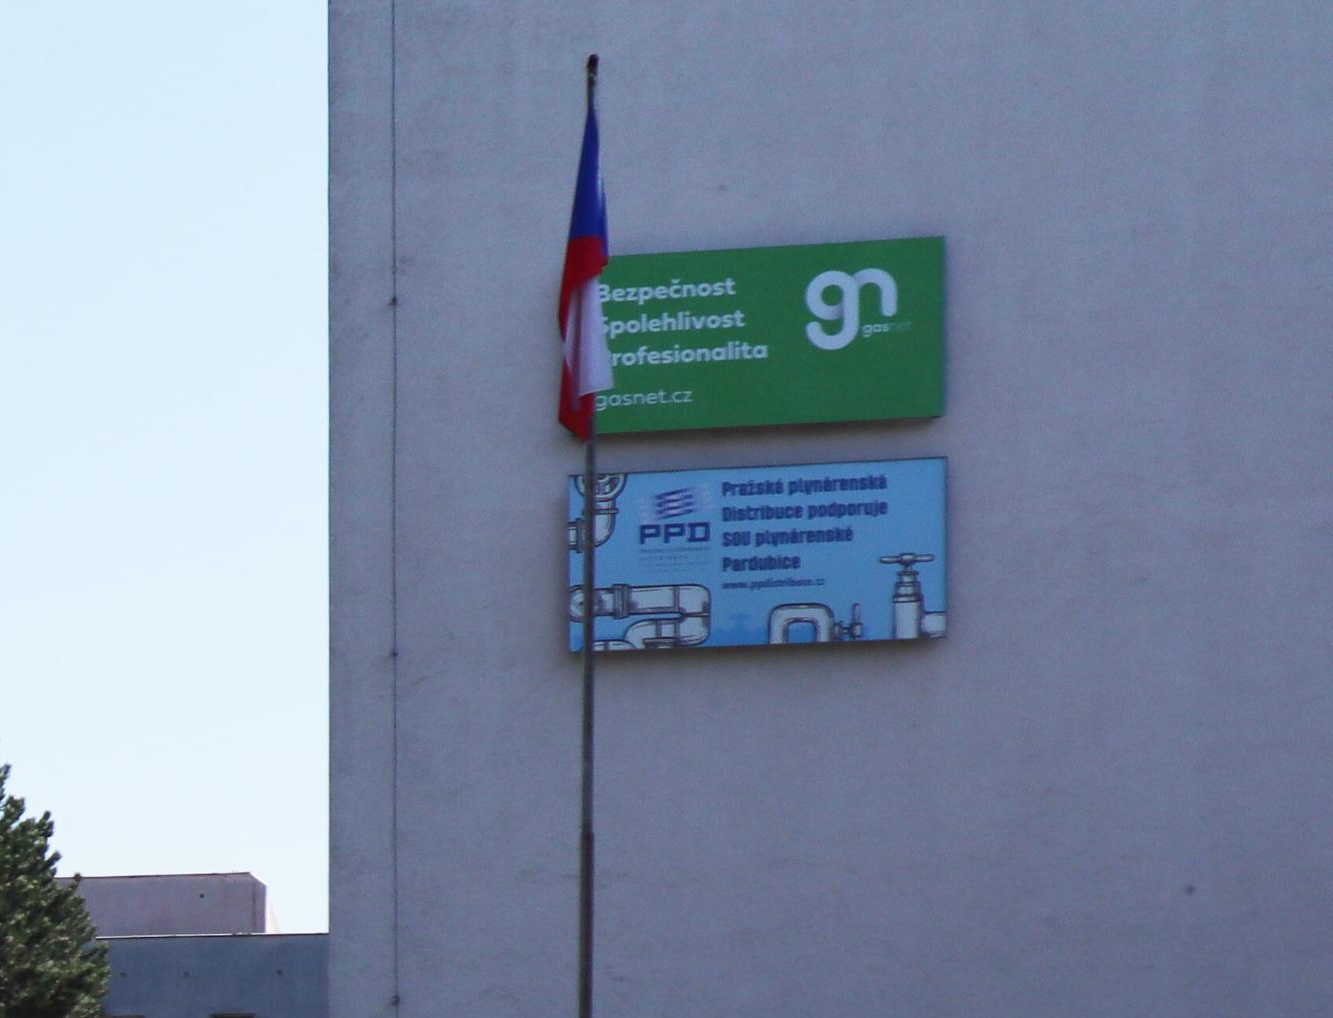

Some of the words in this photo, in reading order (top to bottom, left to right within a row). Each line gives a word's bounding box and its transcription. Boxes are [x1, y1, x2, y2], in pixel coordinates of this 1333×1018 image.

[598, 277, 736, 305] Bezpečnost
[612, 341, 769, 366] rofesionalita
[595, 388, 693, 411] gasnet.cz
[722, 480, 783, 496] Pražská
[788, 474, 888, 495] plynárenská
[722, 504, 803, 522] Distribuce
[808, 500, 889, 520] podporuje
[639, 521, 711, 544] PPD
[722, 531, 751, 547] SOU
[755, 525, 854, 547] plynárenské
[722, 555, 802, 572] Pardubice
